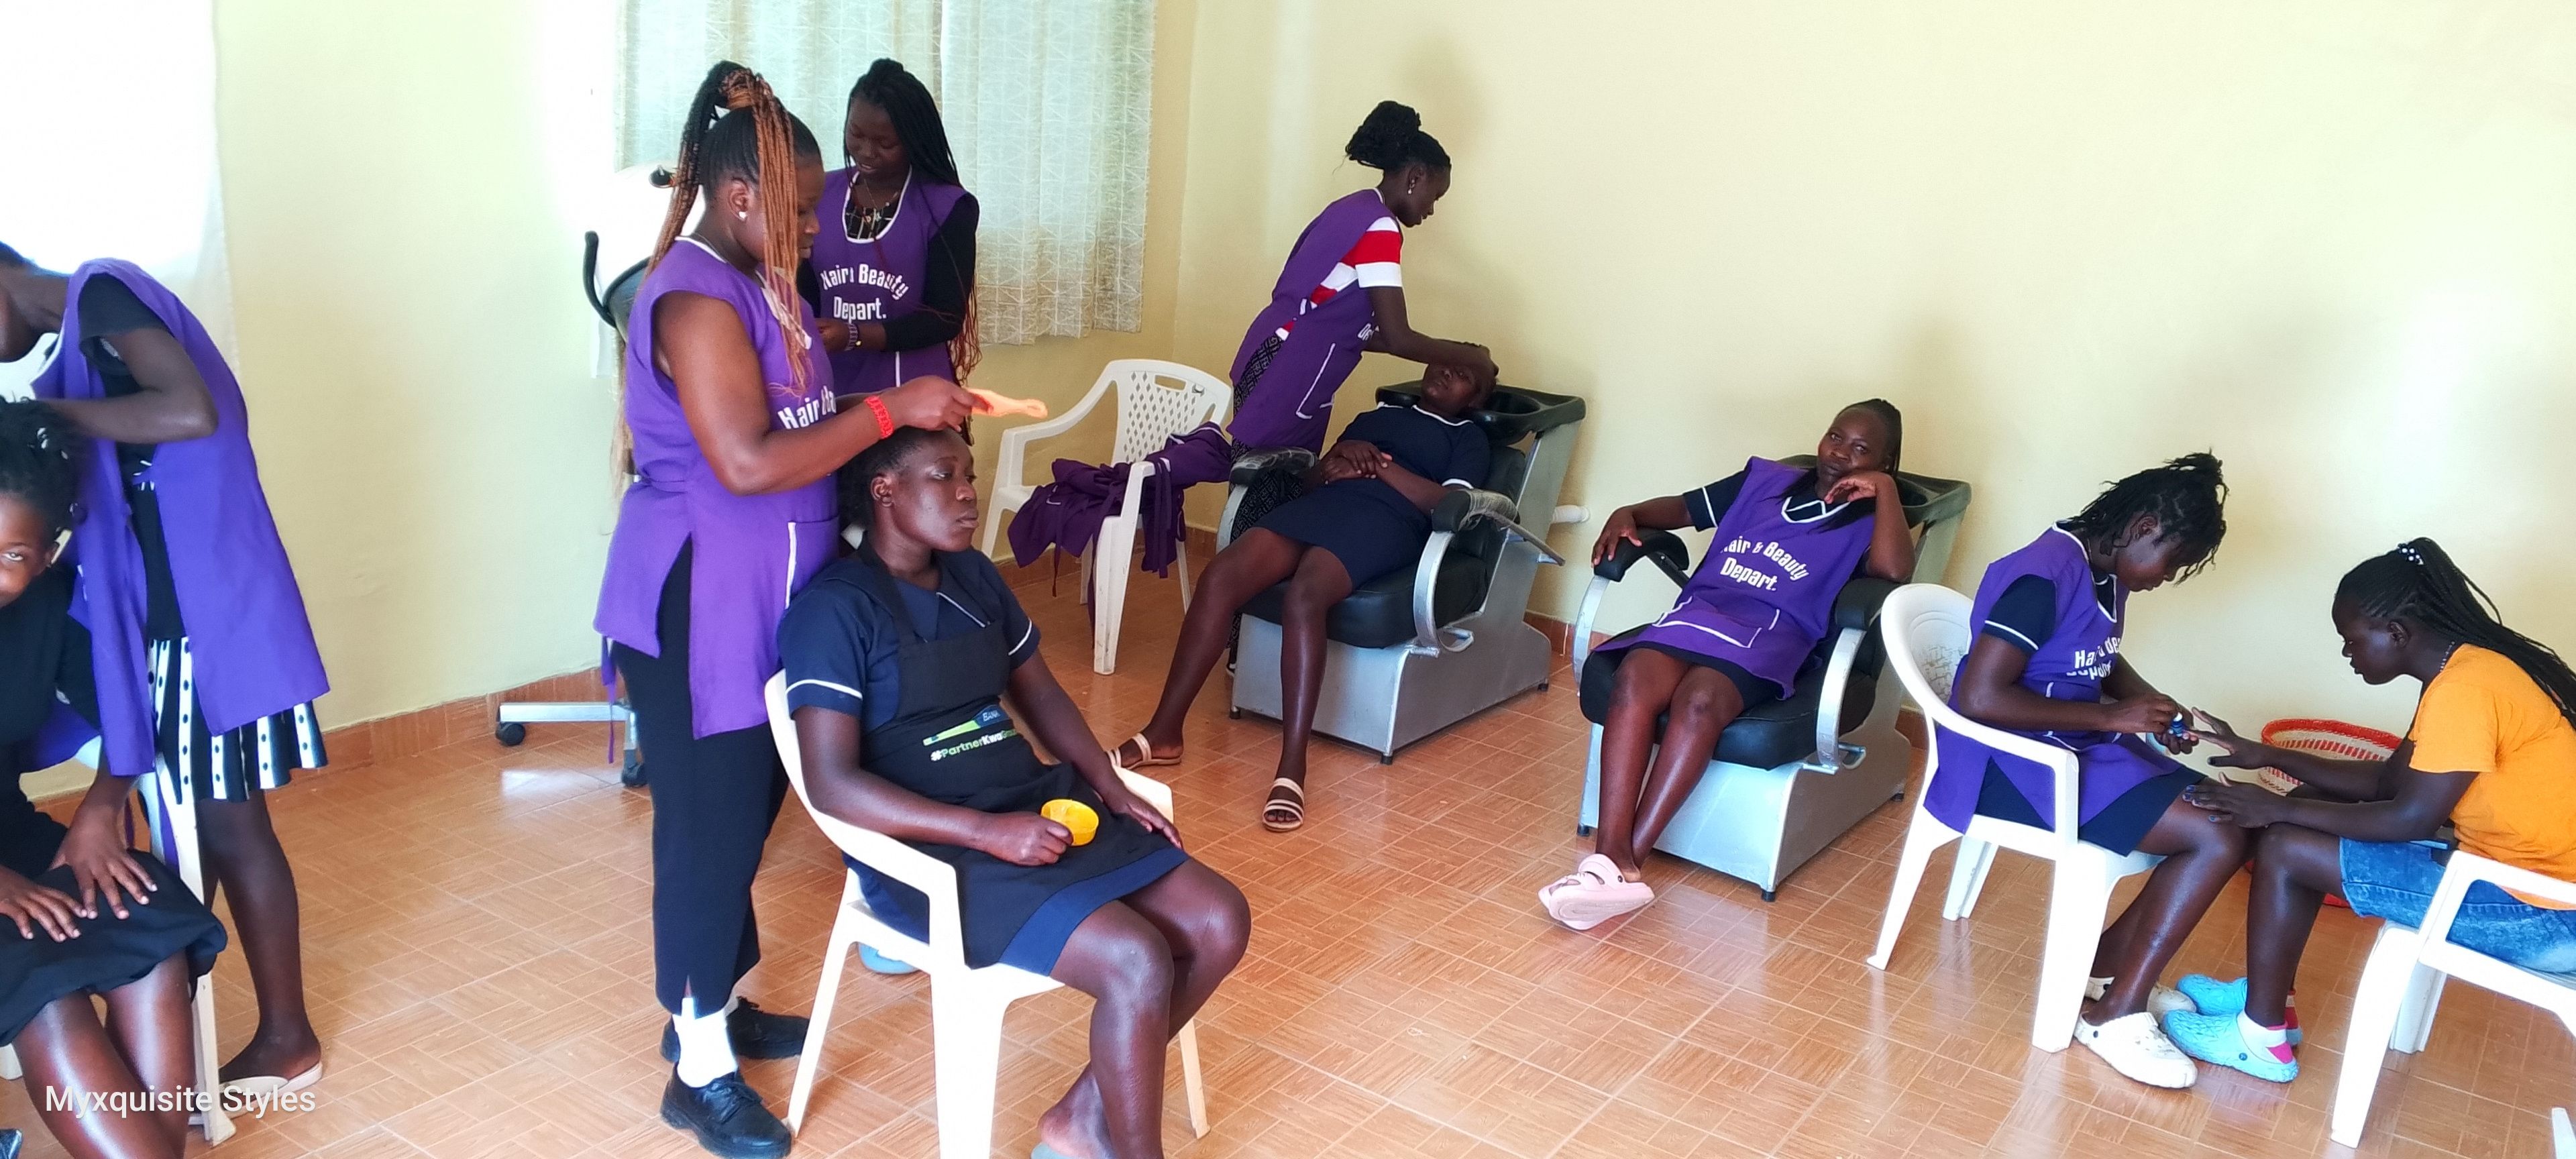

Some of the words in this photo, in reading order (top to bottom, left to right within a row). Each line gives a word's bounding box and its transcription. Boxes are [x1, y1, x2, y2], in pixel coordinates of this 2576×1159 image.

[858, 264, 910, 300] Beauty
[833, 296, 887, 324] Depart.
[777, 397, 820, 429] Hair
[1719, 557, 1778, 592] Depart.
[1720, 535, 1751, 553] air
[1752, 542, 1764, 554] &
[1762, 541, 1810, 582] Beauty
